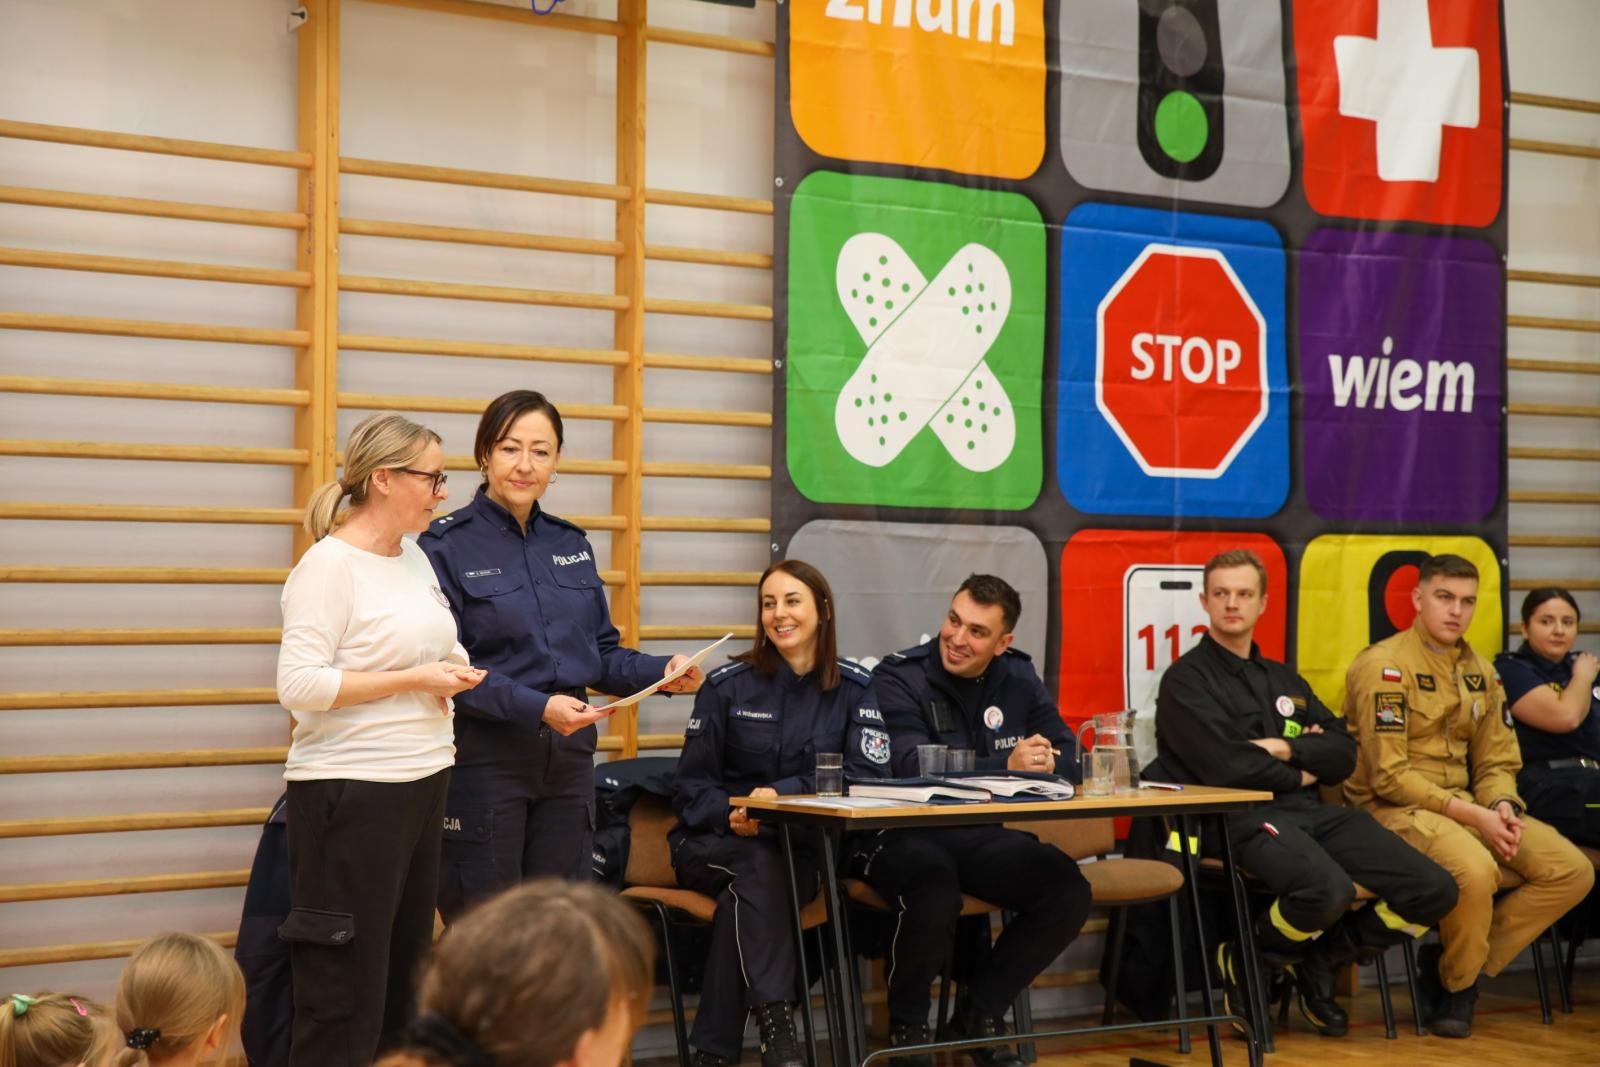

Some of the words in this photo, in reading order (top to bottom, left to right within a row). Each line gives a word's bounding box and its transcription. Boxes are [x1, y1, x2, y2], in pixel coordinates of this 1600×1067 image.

[1130, 333, 1242, 385] STOP
[1328, 336, 1475, 413] wiem
[552, 551, 590, 566] POLICJA
[994, 736, 1025, 751] POLIC
[443, 817, 461, 831] CJA
